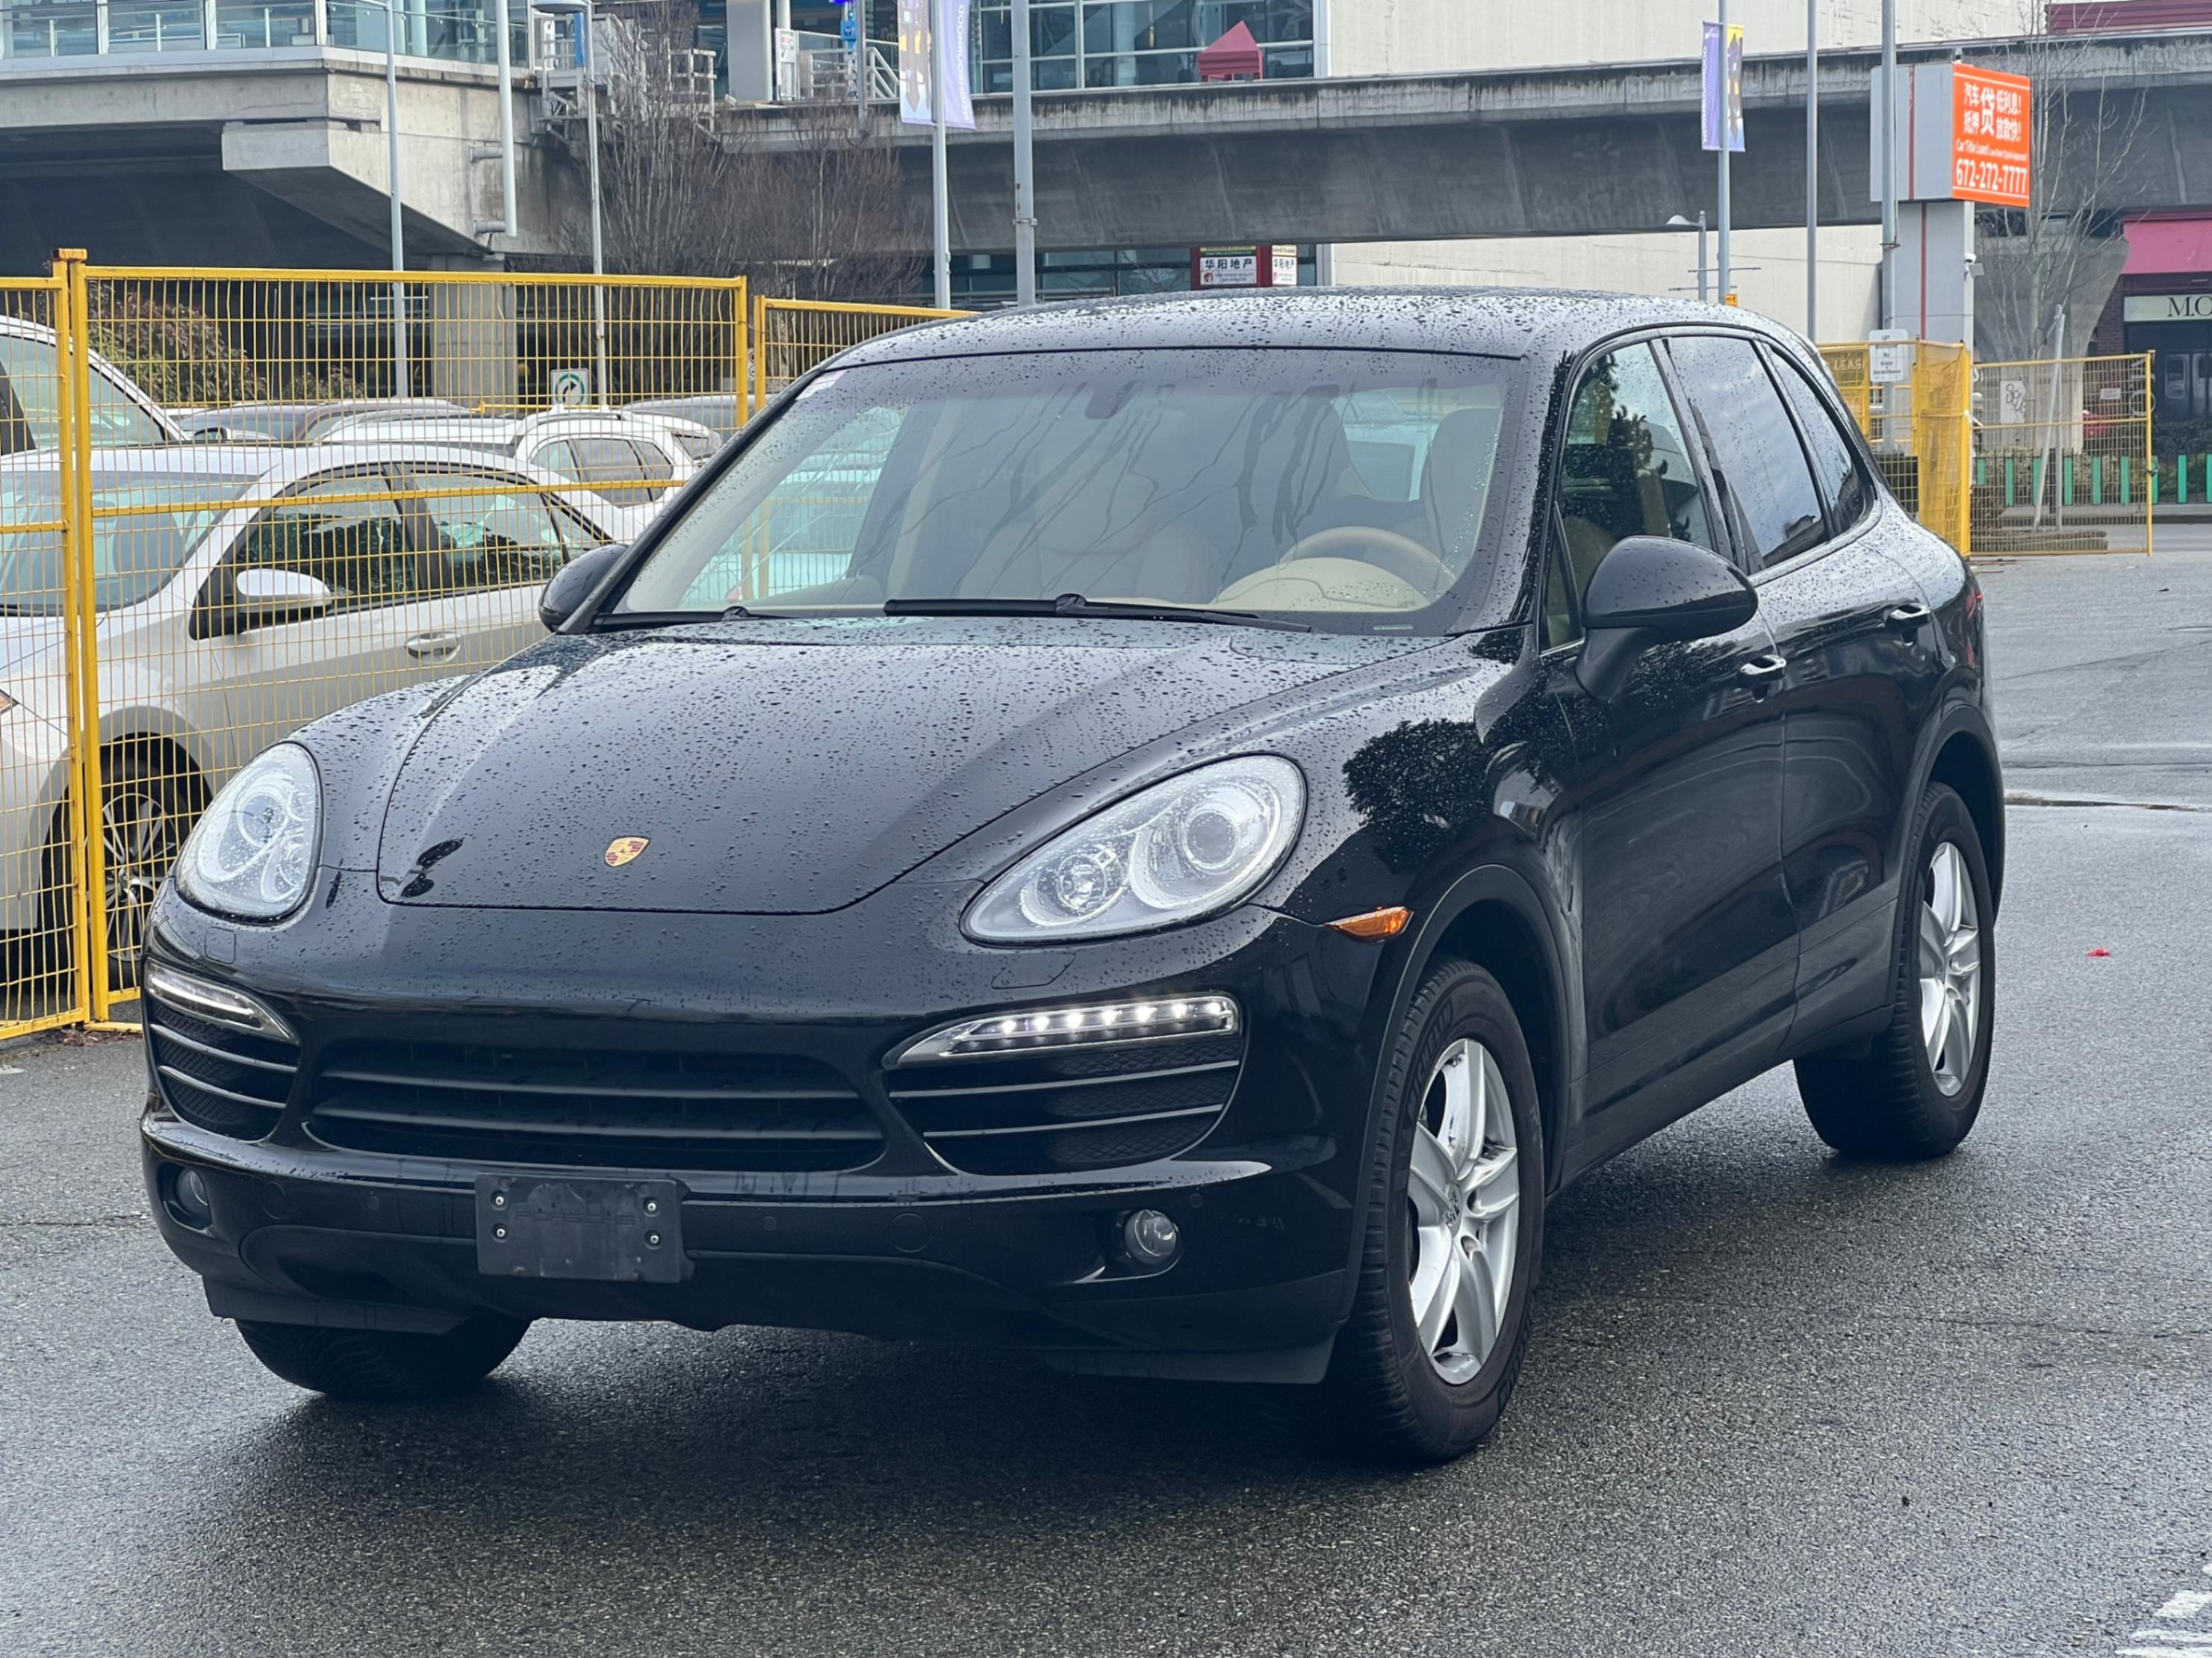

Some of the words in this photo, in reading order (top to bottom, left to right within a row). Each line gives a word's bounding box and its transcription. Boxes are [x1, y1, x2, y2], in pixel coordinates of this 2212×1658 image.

[957, 4, 969, 120] NEIGHBOURHOOD
[1980, 87, 1995, 136] 贷
[1957, 158, 2027, 194] 672-272-7777
[1205, 258, 1252, 270] 华阳地产
